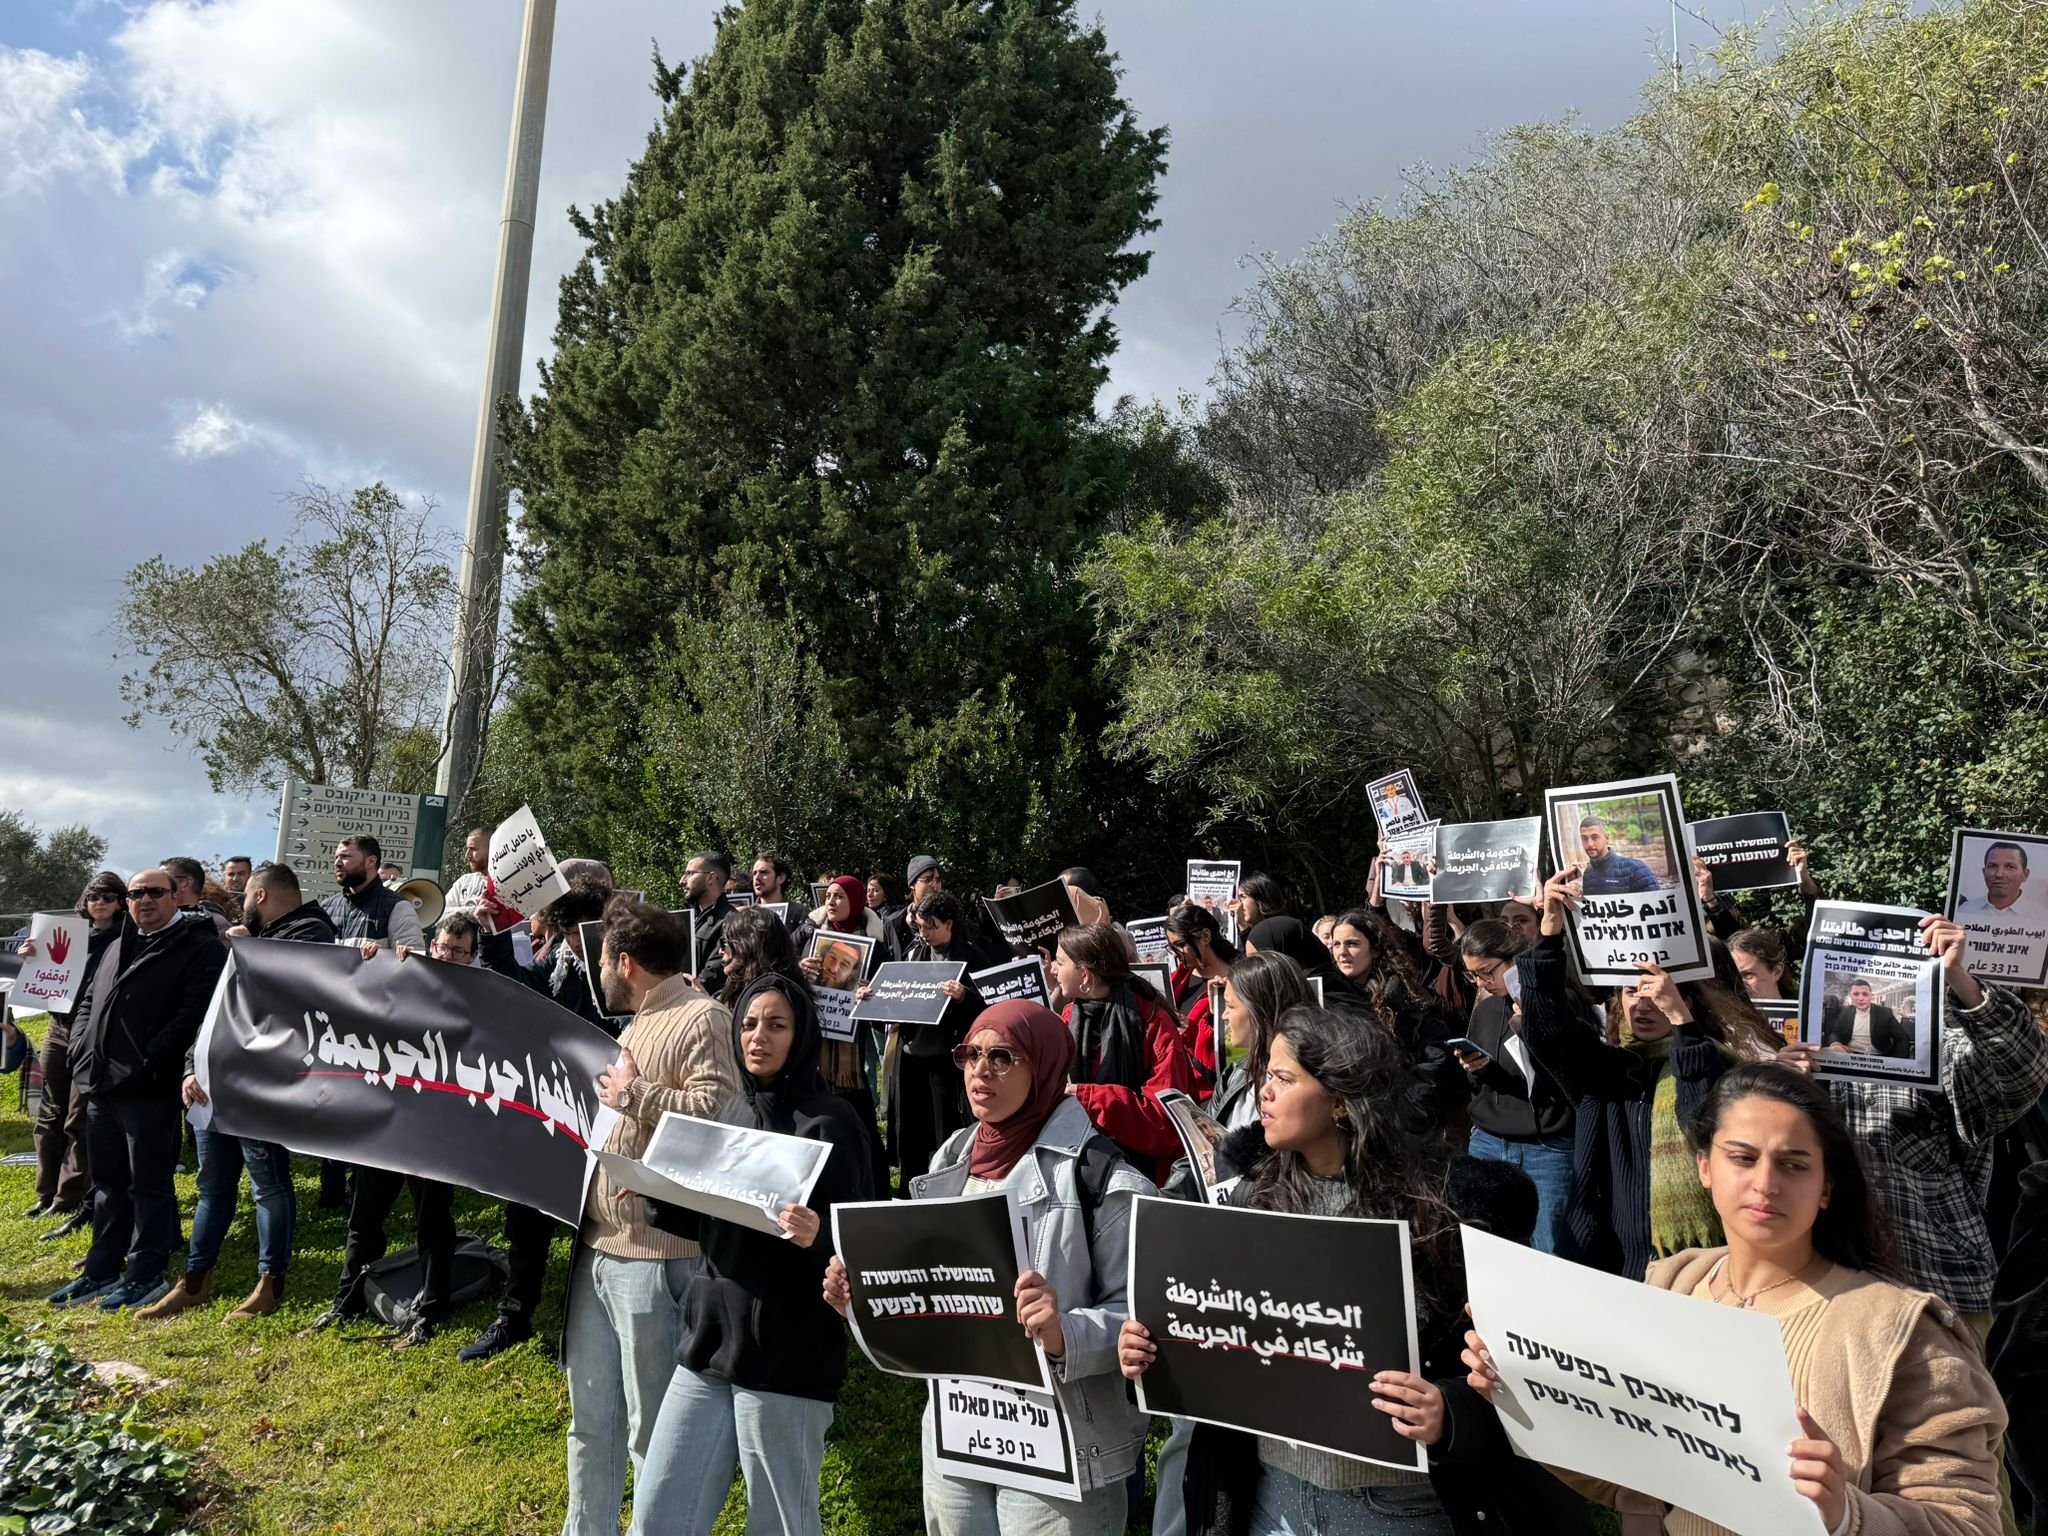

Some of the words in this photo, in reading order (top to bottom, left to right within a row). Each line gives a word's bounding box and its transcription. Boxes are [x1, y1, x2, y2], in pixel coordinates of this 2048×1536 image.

[314, 803, 353, 815] ומדעים
[382, 795, 411, 806] בניין
[357, 807, 384, 819] חינוך
[387, 809, 410, 820] בניין
[337, 821, 373, 833] ראשי
[379, 824, 408, 835] בניין
[1696, 841, 1733, 852] והמשטר
[1736, 837, 1777, 849] הממשלה
[380, 849, 407, 859] מגד
[1447, 848, 1485, 861] والشرطة
[1486, 847, 1522, 857] الحكومة
[1703, 853, 1728, 865] לפש
[1731, 849, 1779, 862] שותפות
[1446, 863, 1479, 875] الجريمة
[1480, 861, 1495, 876] في
[1496, 857, 1521, 870] شركاء
[1580, 899, 1634, 923] خلايلة
[1640, 894, 1677, 921] آدم
[1022, 909, 1060, 929] الحكومة
[1038, 920, 1064, 938] شركاء
[1648, 920, 1686, 939] אדם
[1820, 919, 1866, 937] طالبتنا
[1868, 928, 1910, 942] احدى
[1024, 930, 1037, 946] في
[1968, 940, 2006, 953] אלטורי
[1630, 951, 1648, 962] 20
[1887, 943, 1906, 953] אחת
[1907, 946, 1921, 955] של
[2006, 944, 2029, 955] איוב
[1655, 950, 1670, 964] בן
[1990, 963, 2005, 973] 33
[2008, 964, 2020, 974] בן
[35, 969, 70, 985] أوقفوا
[23, 983, 68, 1000] الجريمة!
[303, 1011, 448, 1094] الجريمة!
[456, 1051, 524, 1116] حرب
[861, 1267, 929, 1286] והמשטרה
[930, 1264, 996, 1283] הממשלה
[867, 1291, 926, 1318] לפשע
[930, 1294, 1004, 1316] שותפות
[1165, 1276, 1258, 1320] والشرطة
[1260, 1290, 1362, 1329] الحكومة
[1167, 1312, 1247, 1351] الجريمة
[1252, 1327, 1290, 1365] في
[1294, 1334, 1364, 1370] شركاء
[1506, 1330, 1616, 1388] בפשיעה
[948, 1390, 990, 1417] סאלח
[1523, 1377, 1604, 1419] הנשק
[1619, 1373, 1741, 1434] להיאבק
[993, 1400, 1019, 1422] אבו
[1021, 1402, 1049, 1428] עלי
[1609, 1406, 1658, 1437] את
[996, 1437, 1016, 1455] 30
[1019, 1441, 1036, 1461] בן
[1662, 1423, 1762, 1483] לאסוף
